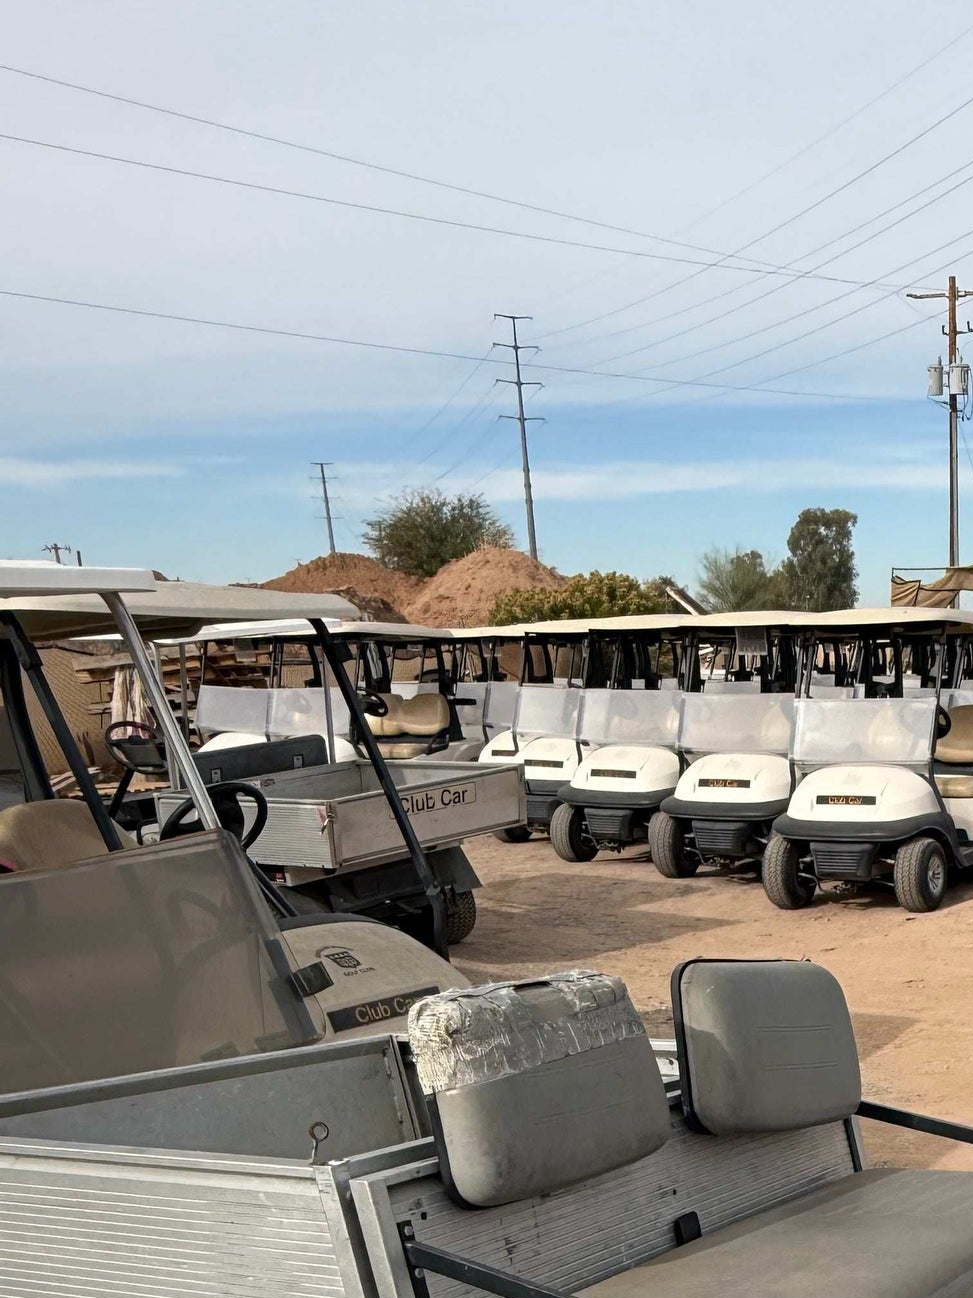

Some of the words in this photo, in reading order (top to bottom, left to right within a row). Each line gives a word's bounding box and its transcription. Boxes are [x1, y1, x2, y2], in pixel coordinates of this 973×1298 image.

[400, 793, 435, 813] Club
[441, 789, 467, 806] Car
[355, 1001, 390, 1023] Club
[394, 997, 418, 1013] Ca
